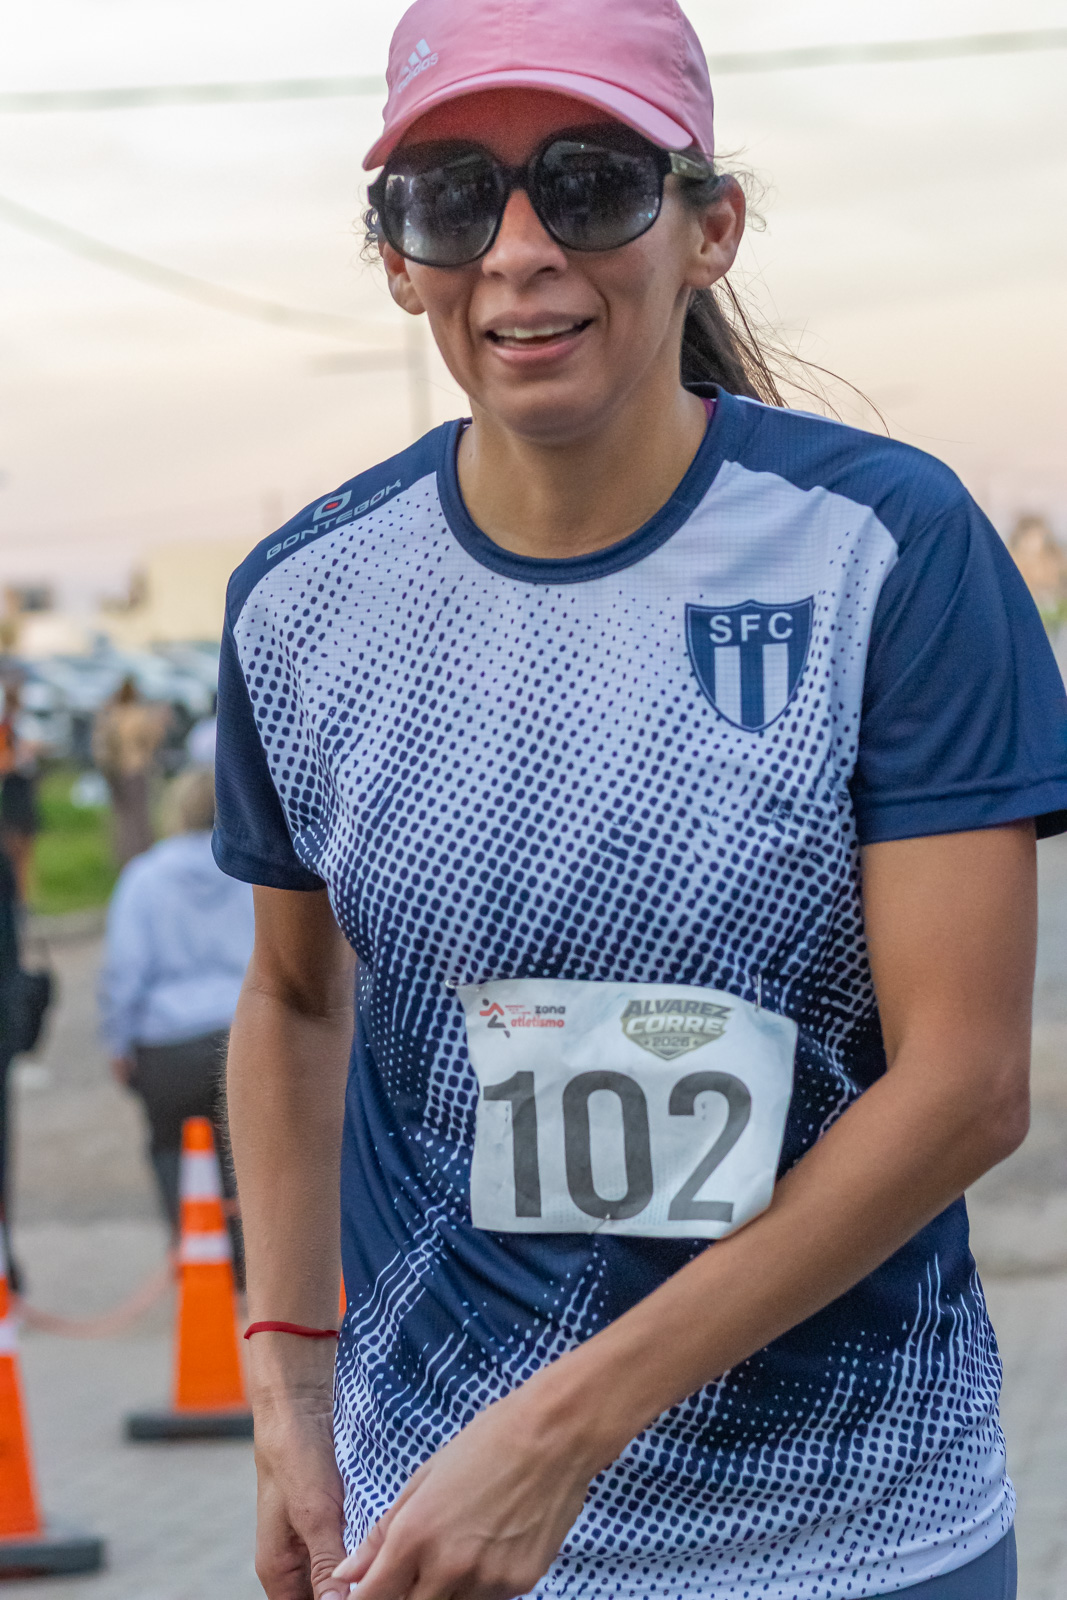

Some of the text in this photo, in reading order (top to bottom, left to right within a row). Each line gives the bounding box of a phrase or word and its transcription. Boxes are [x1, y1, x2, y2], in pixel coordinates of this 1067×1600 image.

[709, 611, 793, 643] SFC
[535, 1005, 566, 1014] zona
[622, 999, 732, 1019] ALVAREZ
[511, 1015, 565, 1028] atletismo
[626, 1015, 724, 1034] CORRE
[483, 1070, 752, 1223] 102
